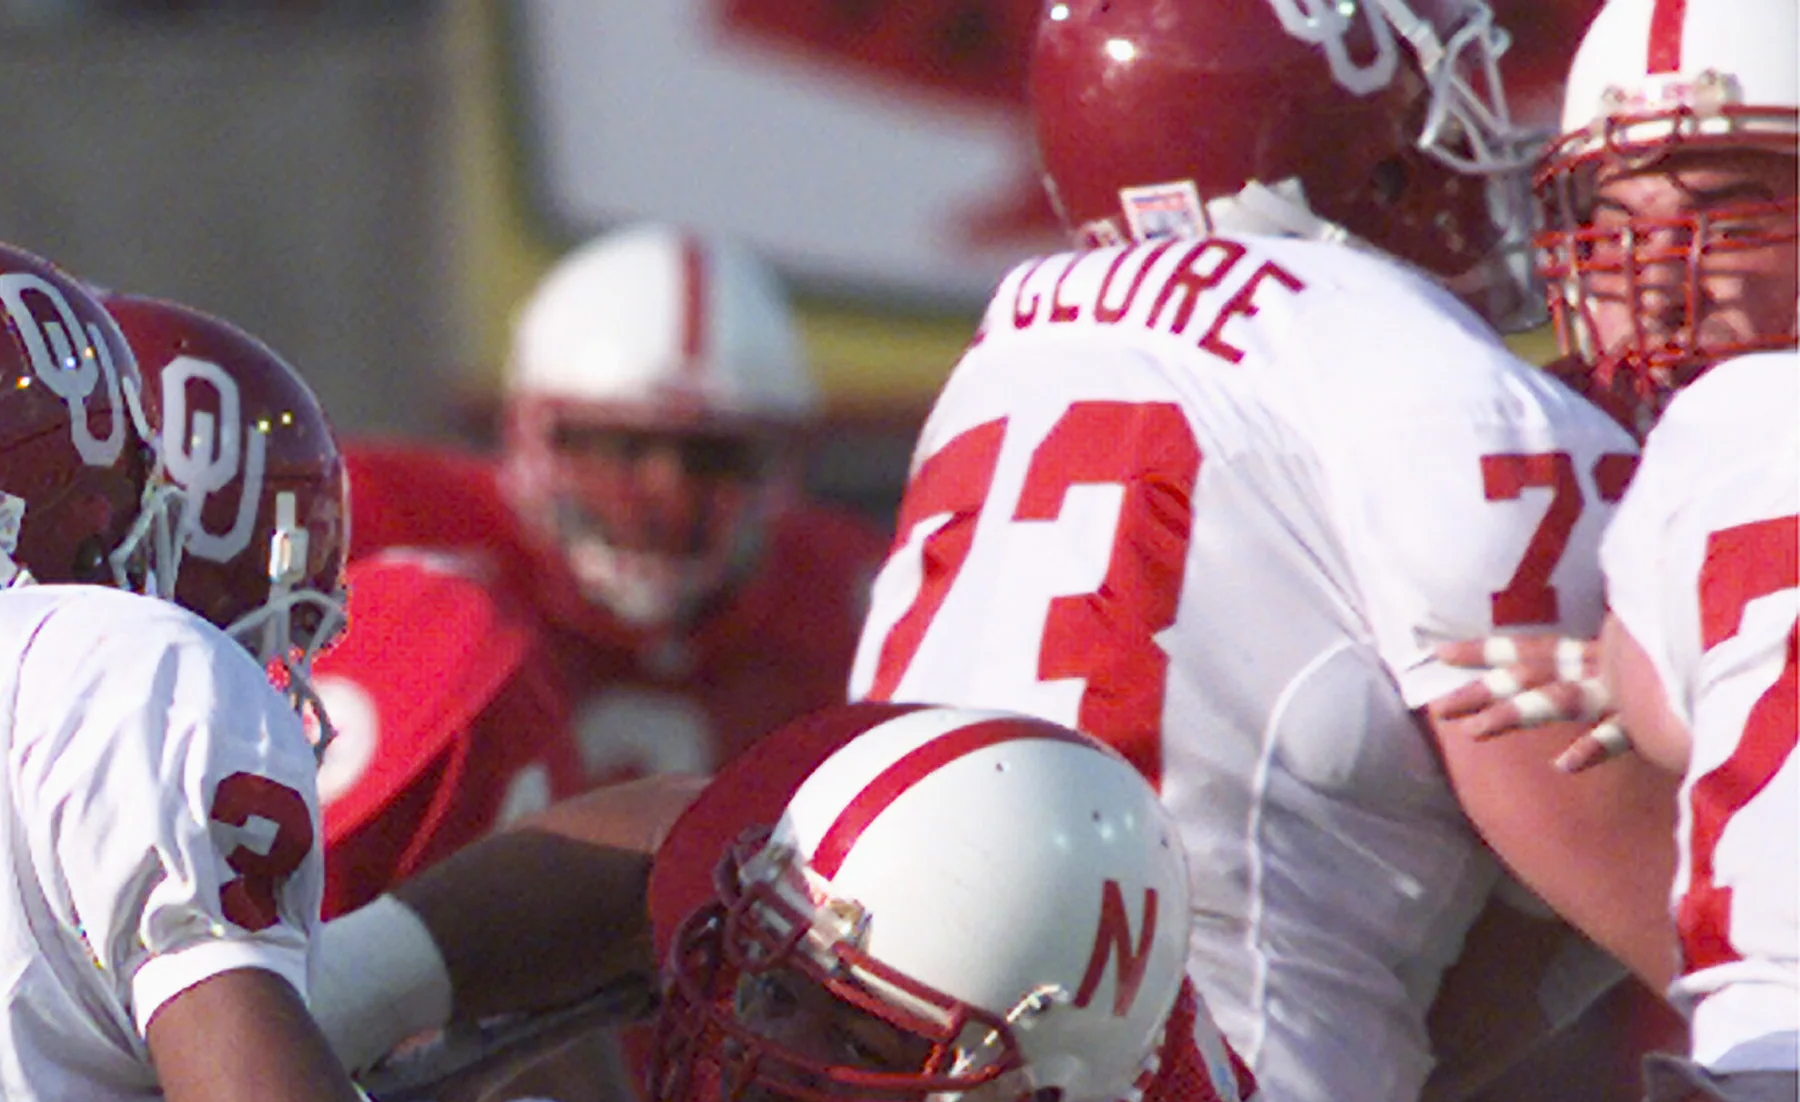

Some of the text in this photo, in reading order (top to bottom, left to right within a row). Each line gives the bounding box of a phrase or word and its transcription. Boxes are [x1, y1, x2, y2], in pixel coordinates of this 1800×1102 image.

[0, 272, 128, 466] OU
[972, 237, 1308, 365] CLURE
[162, 356, 267, 561] OU
[865, 401, 1205, 800] 73
[210, 771, 314, 930] 3
[1074, 880, 1158, 1016] N
